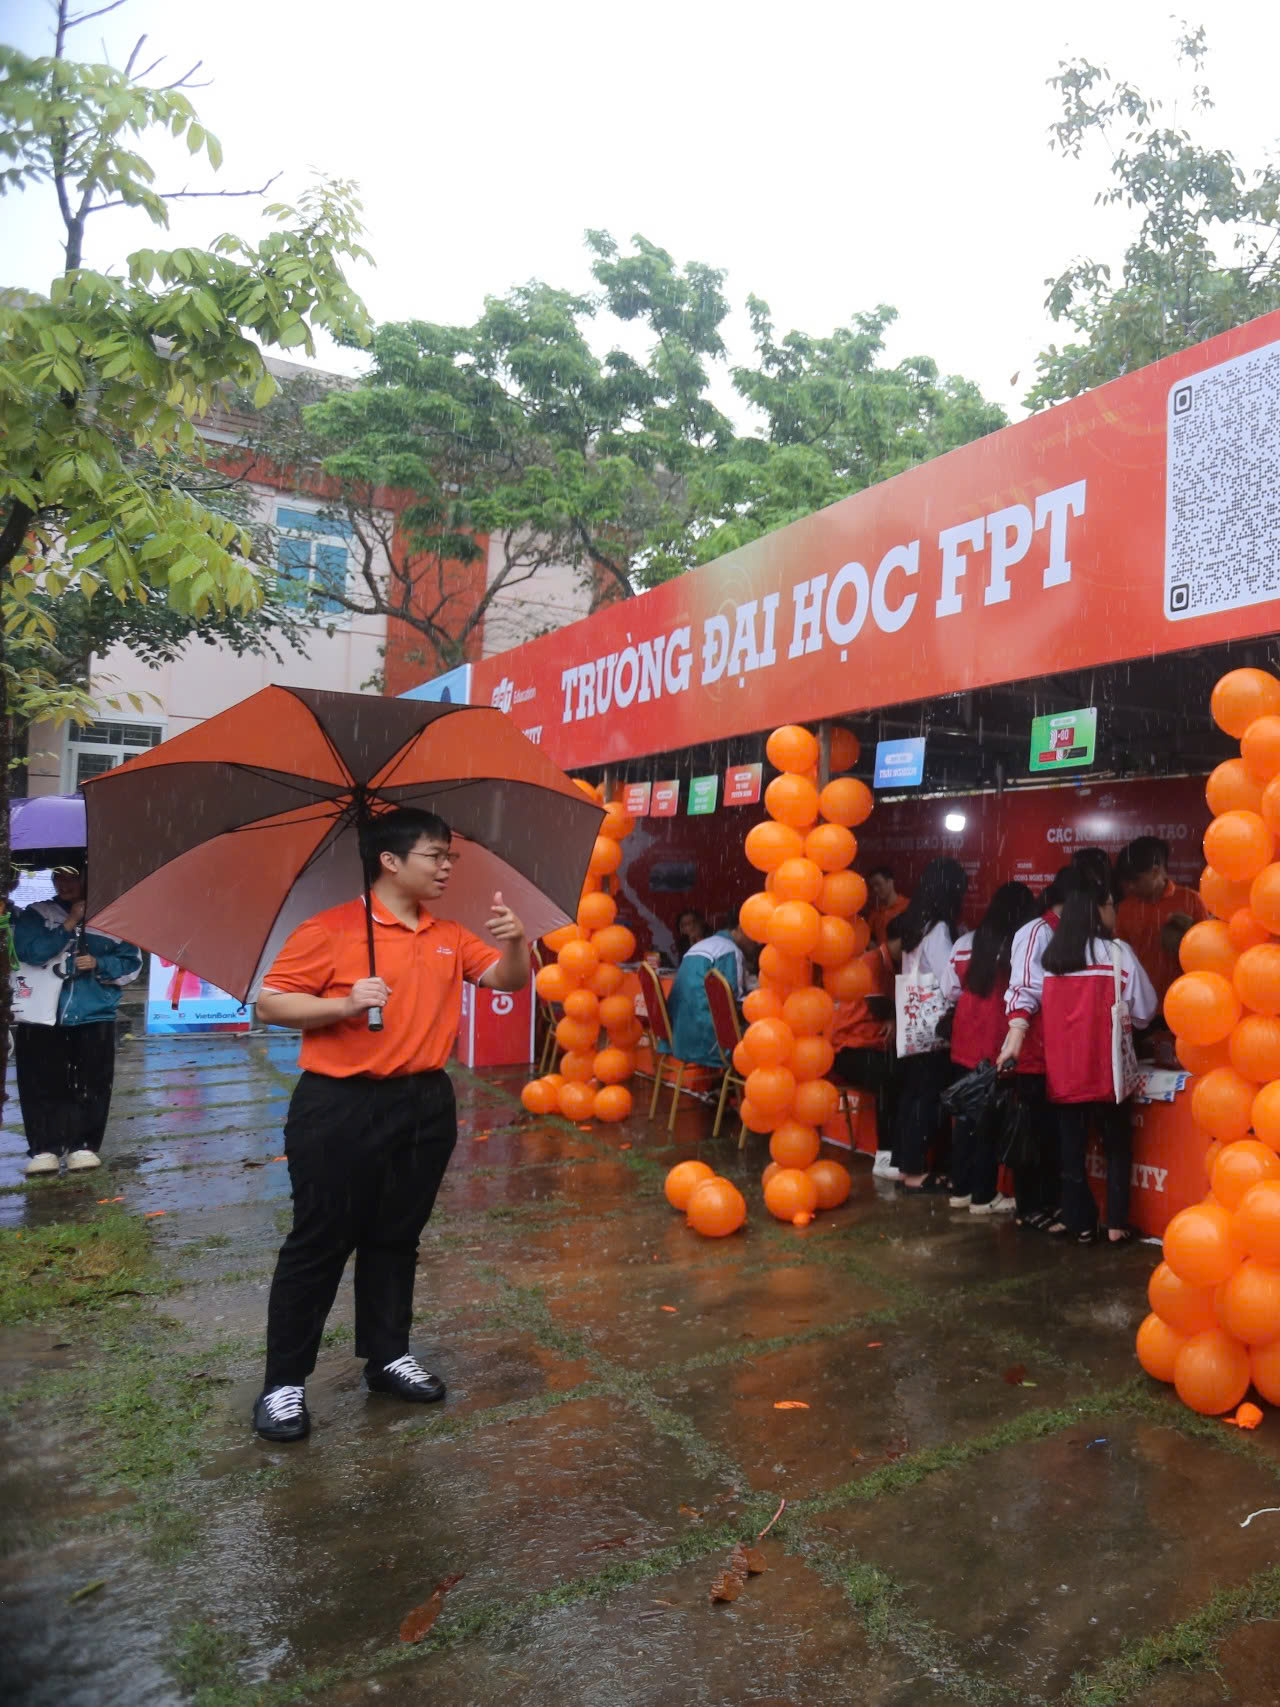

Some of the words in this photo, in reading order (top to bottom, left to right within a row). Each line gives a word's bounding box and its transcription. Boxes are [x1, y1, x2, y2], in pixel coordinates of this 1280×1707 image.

[561, 624, 693, 724] TRƯỜNG
[701, 593, 780, 688] ĐẠI
[789, 541, 920, 662] HỌC
[935, 479, 1087, 619] FPT
